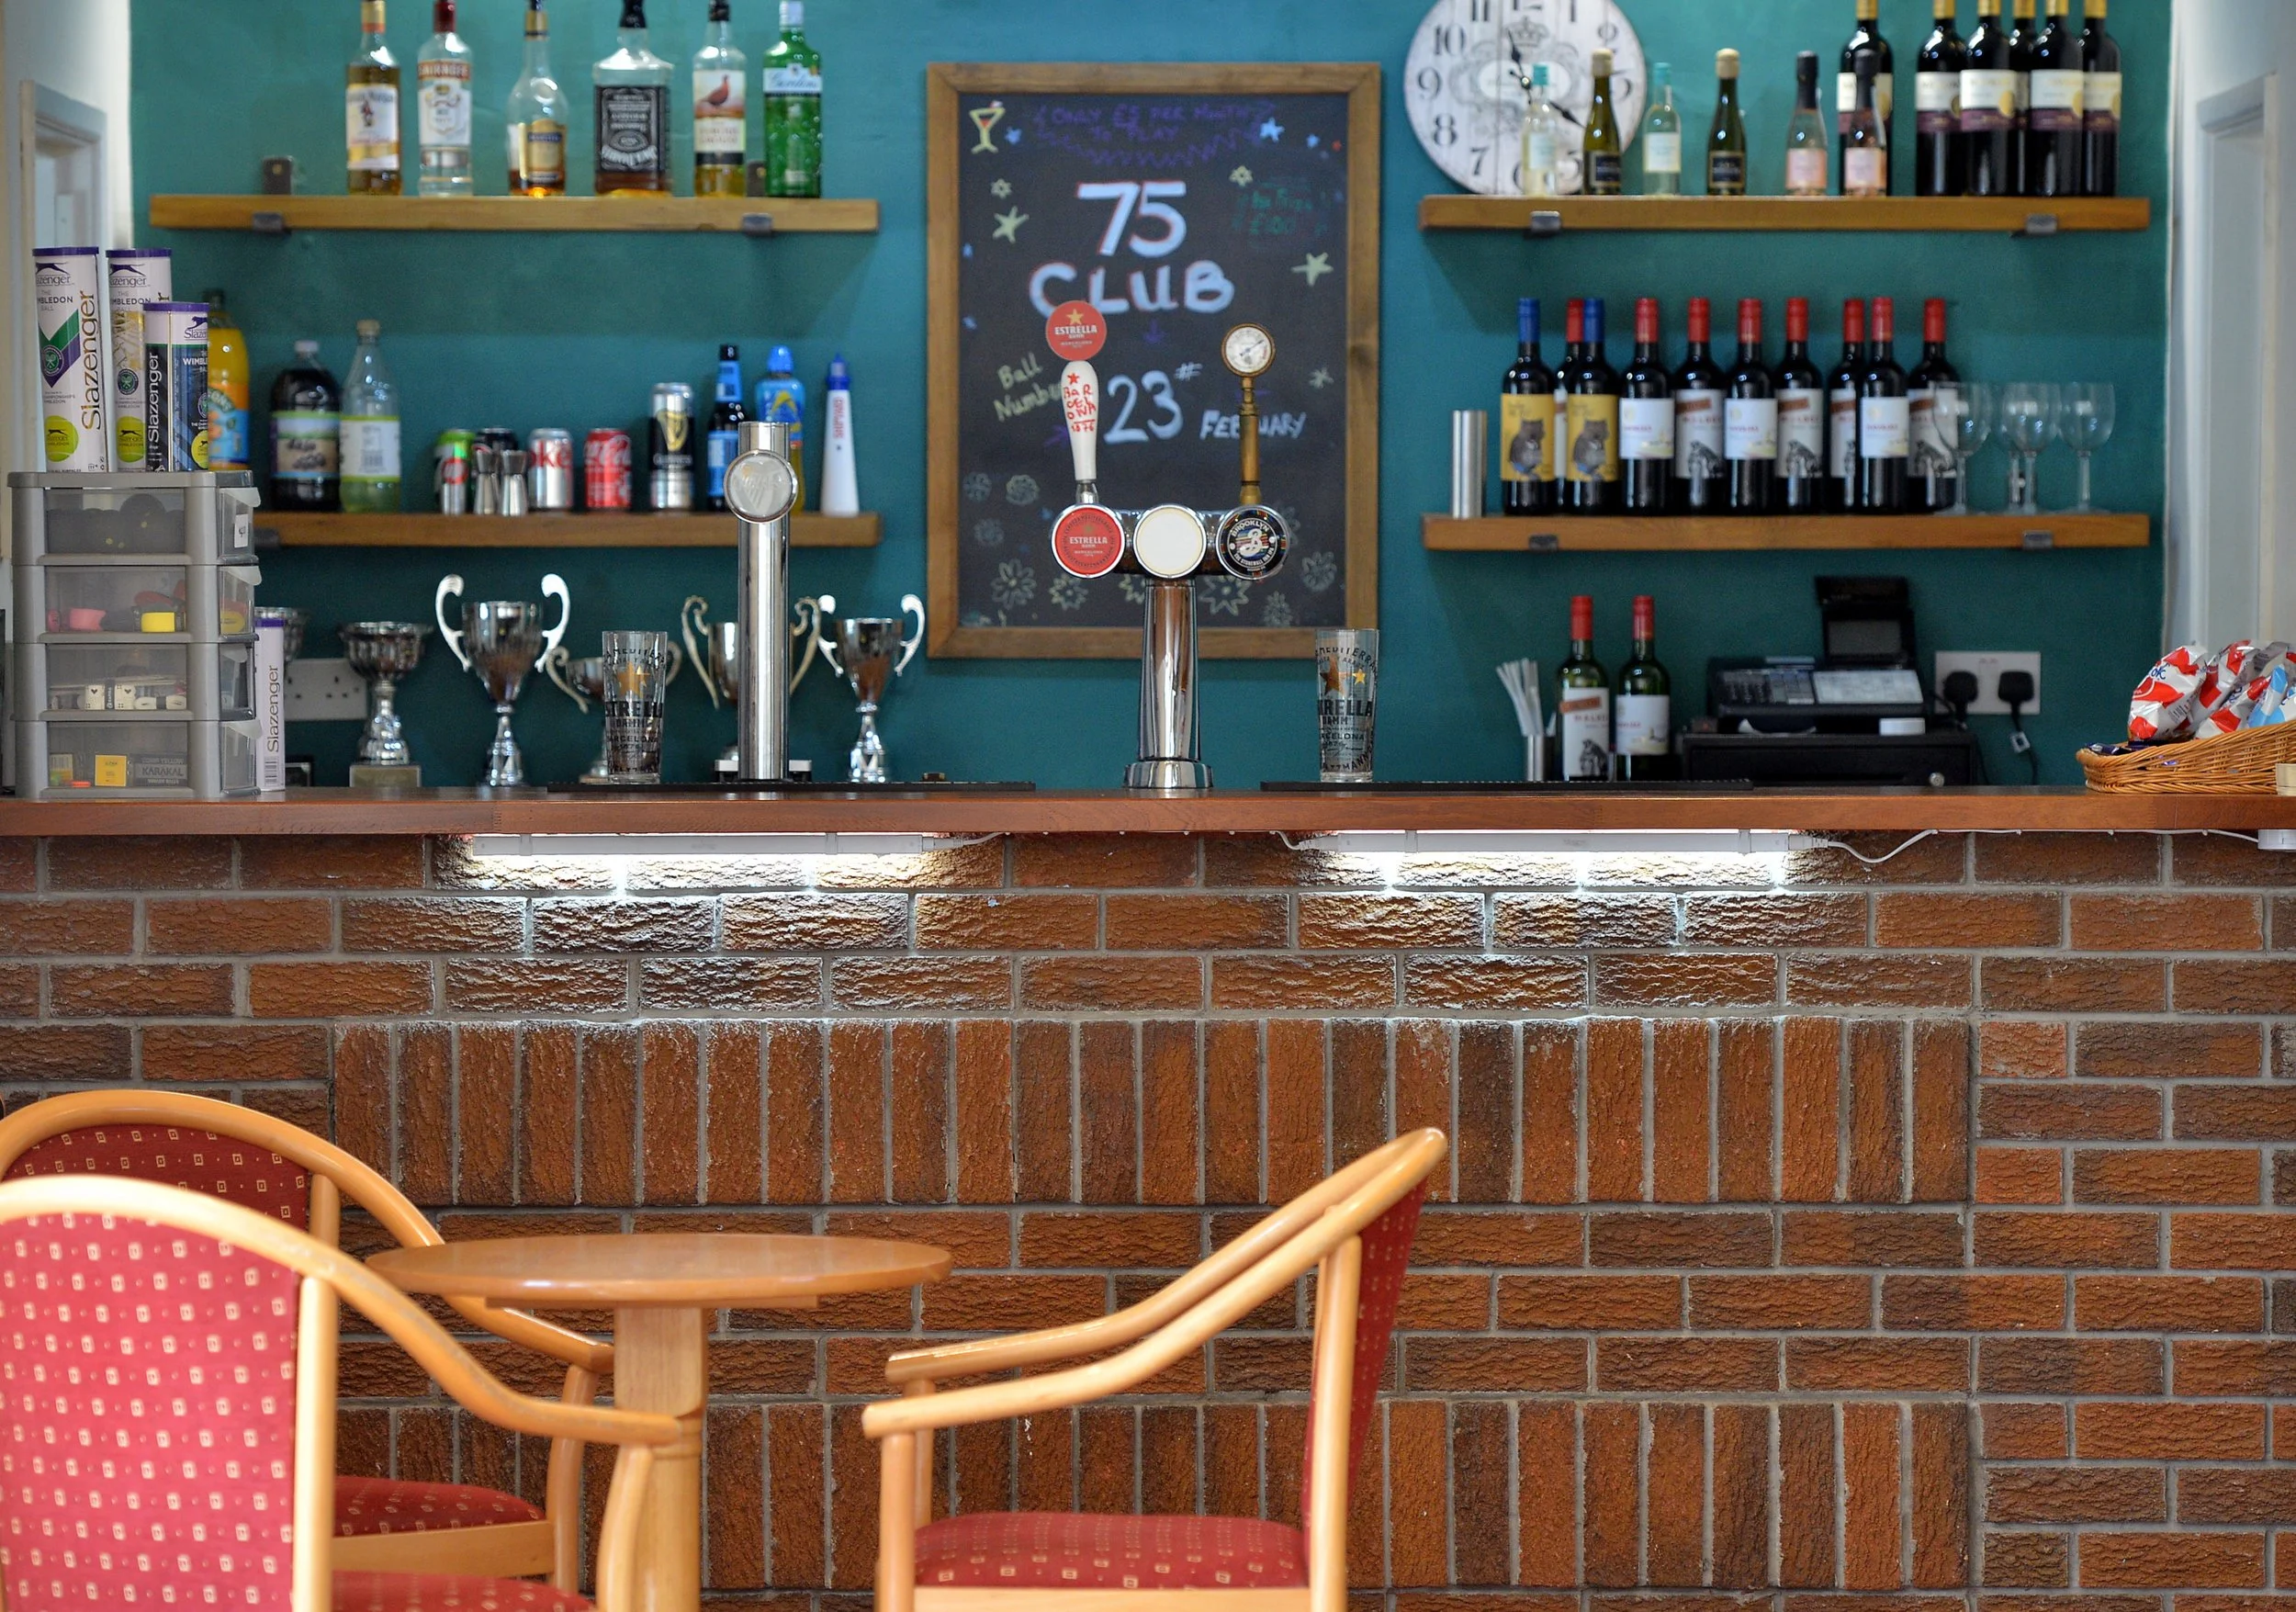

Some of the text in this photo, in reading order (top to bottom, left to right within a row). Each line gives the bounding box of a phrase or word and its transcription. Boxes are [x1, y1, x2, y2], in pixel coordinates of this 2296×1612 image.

[1434, 24, 1466, 56] 10
[1417, 66, 1442, 99] 9
[1433, 112, 1458, 146] 8
[1470, 146, 1490, 176] 7
[1076, 179, 1187, 257] 75
[1029, 259, 1235, 319] CLUB
[1053, 324, 1098, 335] ESTRELLA
[81, 289, 102, 431] Slazenger
[183, 357, 208, 366] WIMBL
[996, 351, 1043, 390] Ball
[148, 352, 163, 444] Slazenger
[1103, 369, 1184, 445] 23
[1199, 409, 1308, 440] FEBUARY
[1069, 536, 1109, 545] ESTRELLA
[1231, 520, 1269, 537] BROOKLYN
[266, 664, 281, 754] Slazenger
[141, 766, 185, 777] KARAKAL
